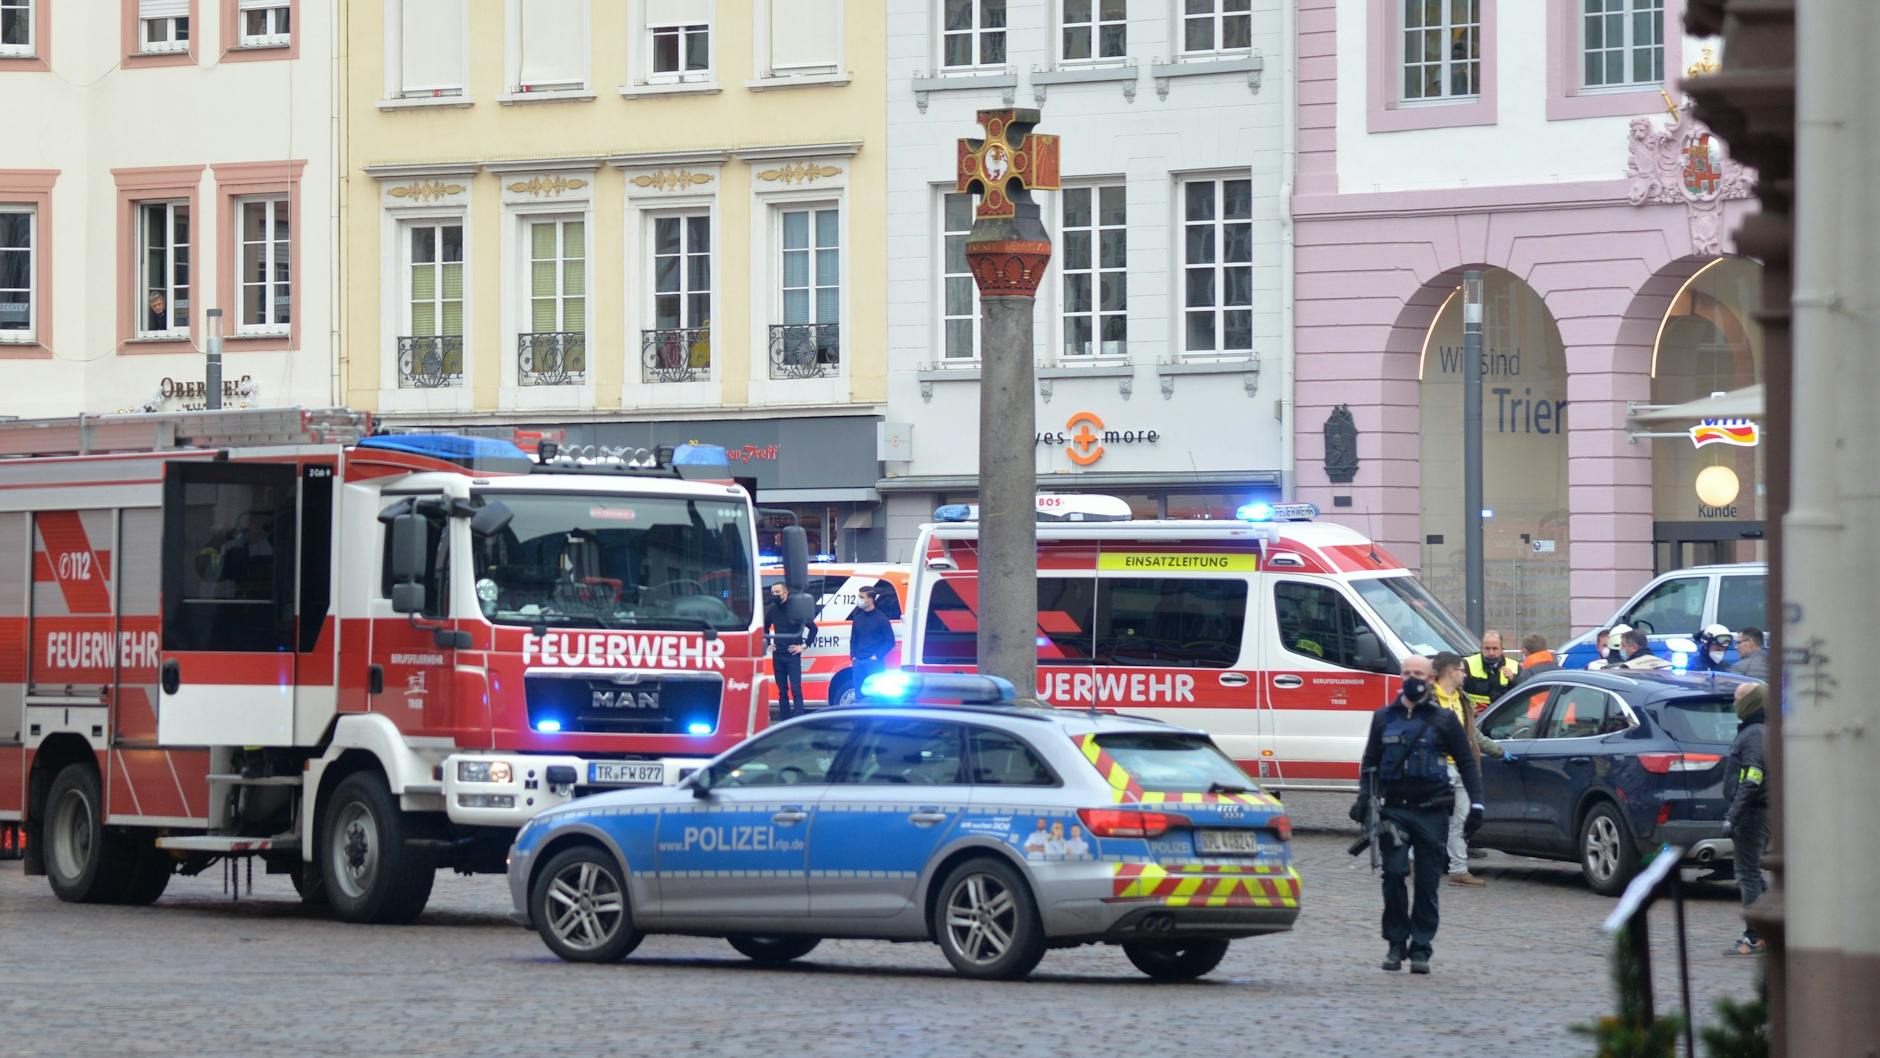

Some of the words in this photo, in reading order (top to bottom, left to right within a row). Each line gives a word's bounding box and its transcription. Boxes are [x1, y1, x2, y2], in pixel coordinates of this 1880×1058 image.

[1440, 346, 1464, 374] Wi
[1492, 387, 1568, 435] Trier
[1104, 429, 1157, 443] more
[1698, 504, 1738, 518] Kunde
[71, 552, 91, 580] 112
[1125, 556, 1229, 568] EINSATZLEITUNG
[843, 594, 857, 605] 112
[47, 631, 160, 669] FEUERWEHR
[522, 633, 726, 669] FEUERWEHR
[592, 691, 659, 709] MAN
